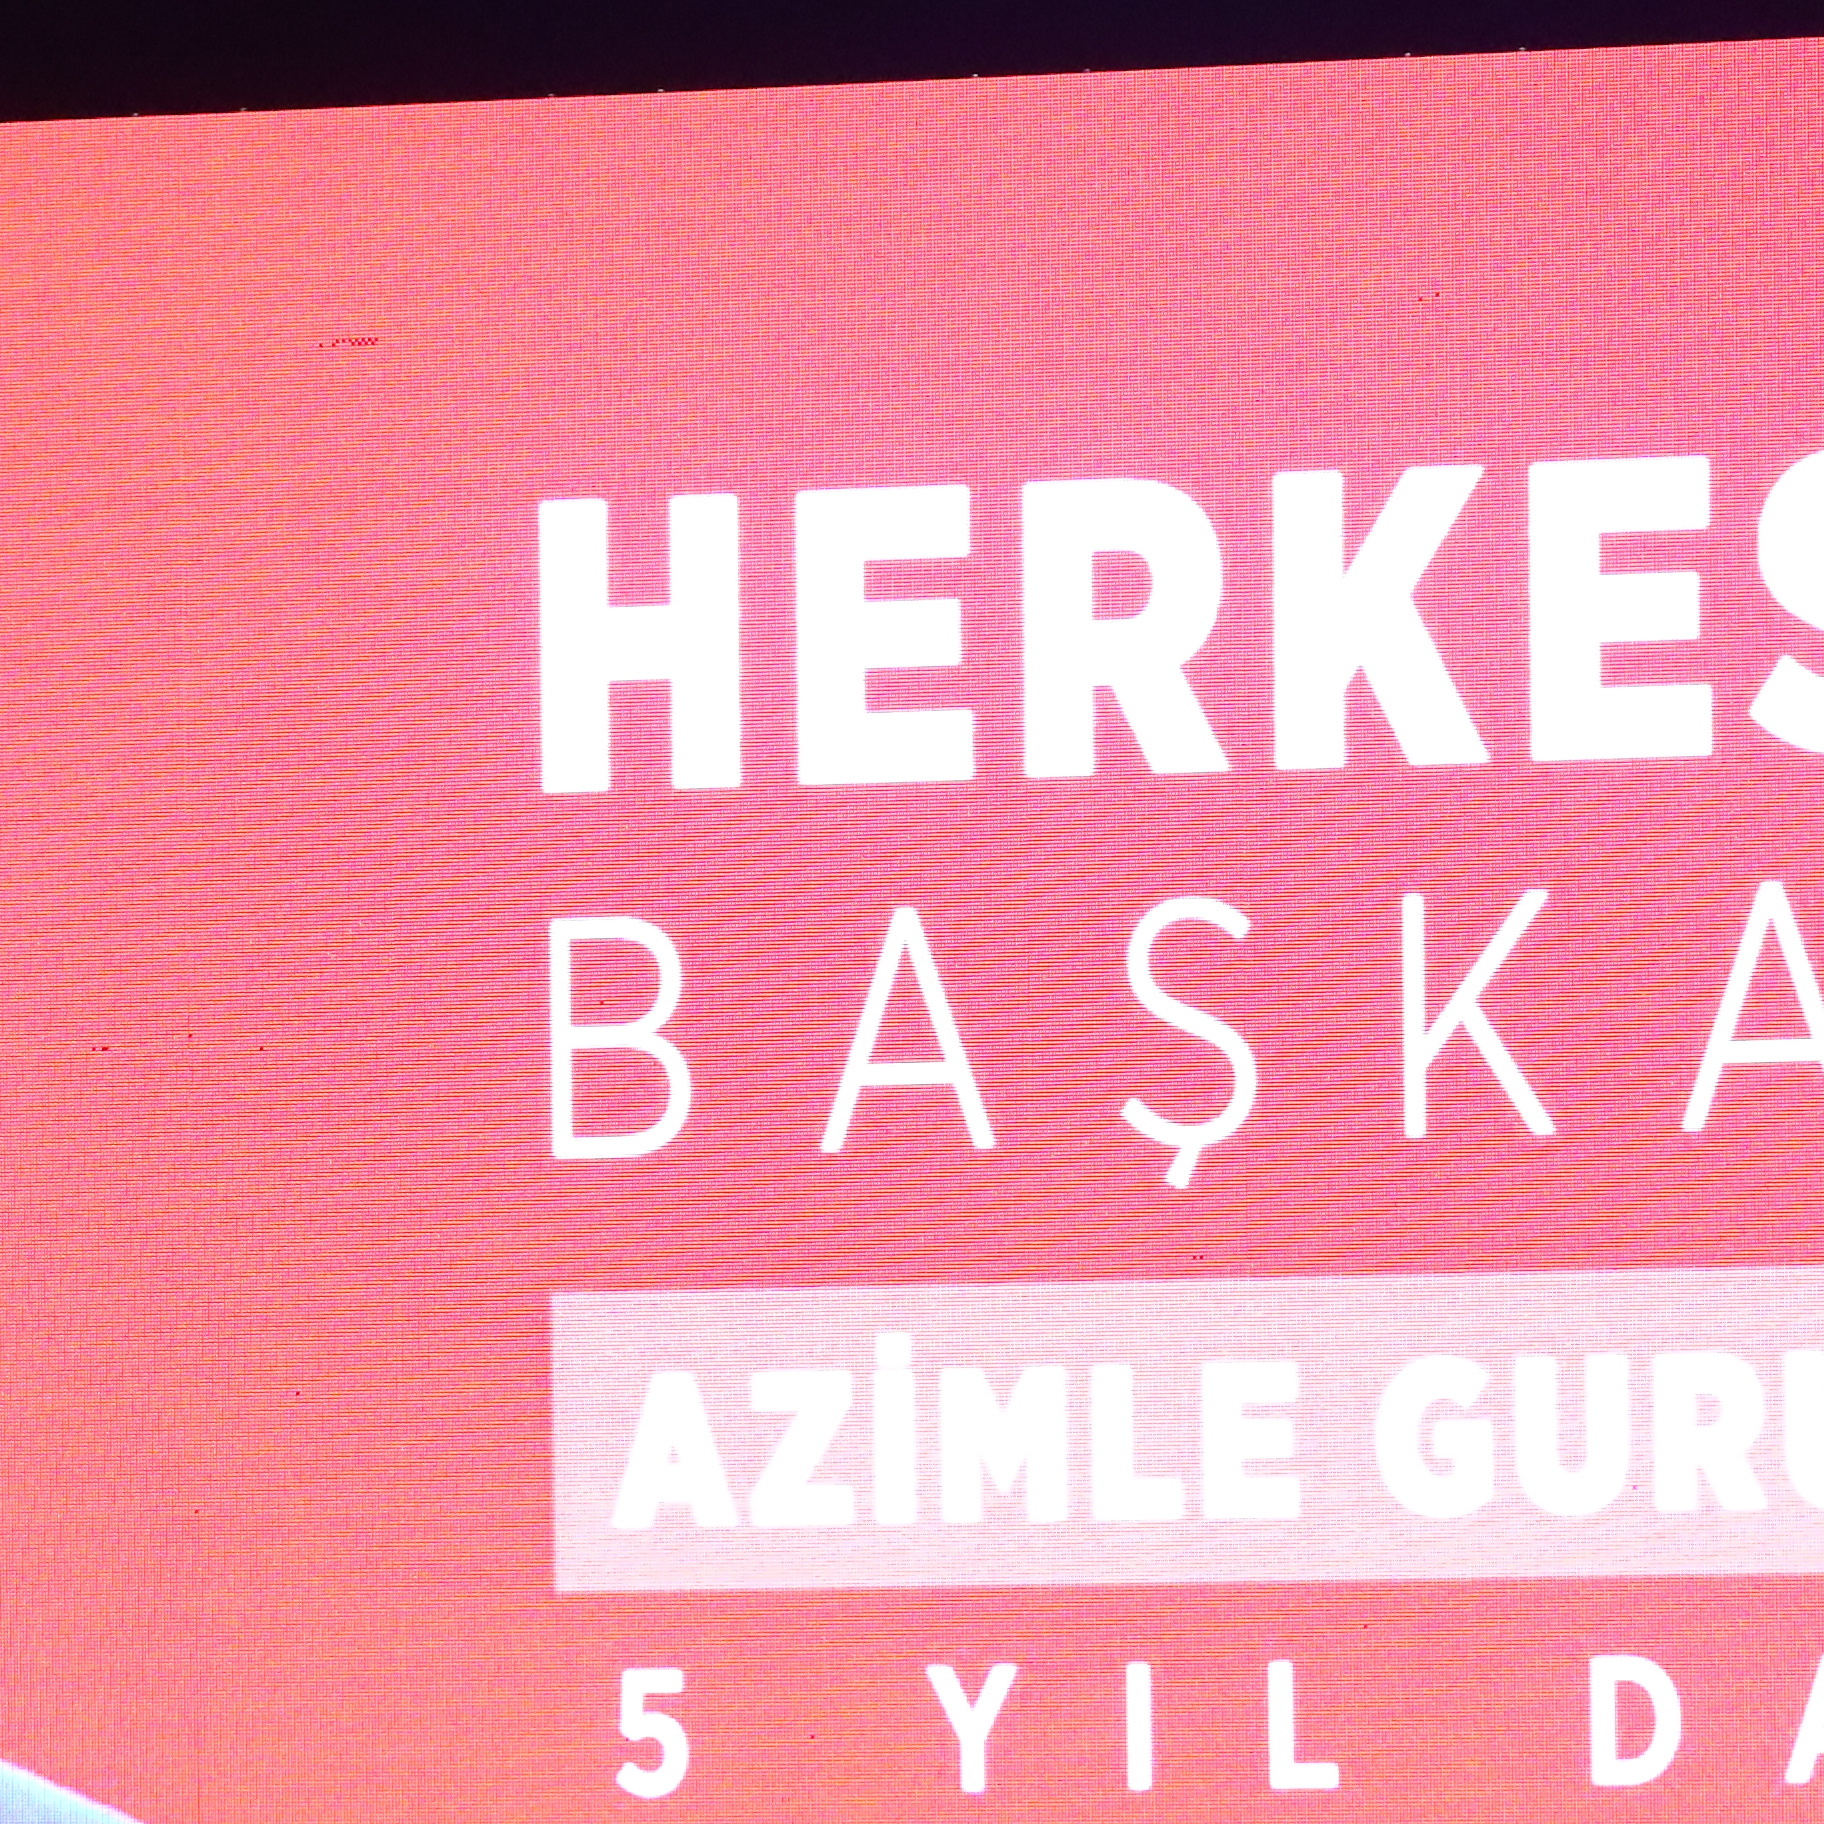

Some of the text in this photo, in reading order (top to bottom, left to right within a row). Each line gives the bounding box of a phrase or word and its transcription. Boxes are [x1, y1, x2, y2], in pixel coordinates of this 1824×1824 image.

[609, 1330, 1303, 1532] AZİMLE
[616, 1666, 690, 1799] 5
[926, 1658, 1341, 1794] YIL
